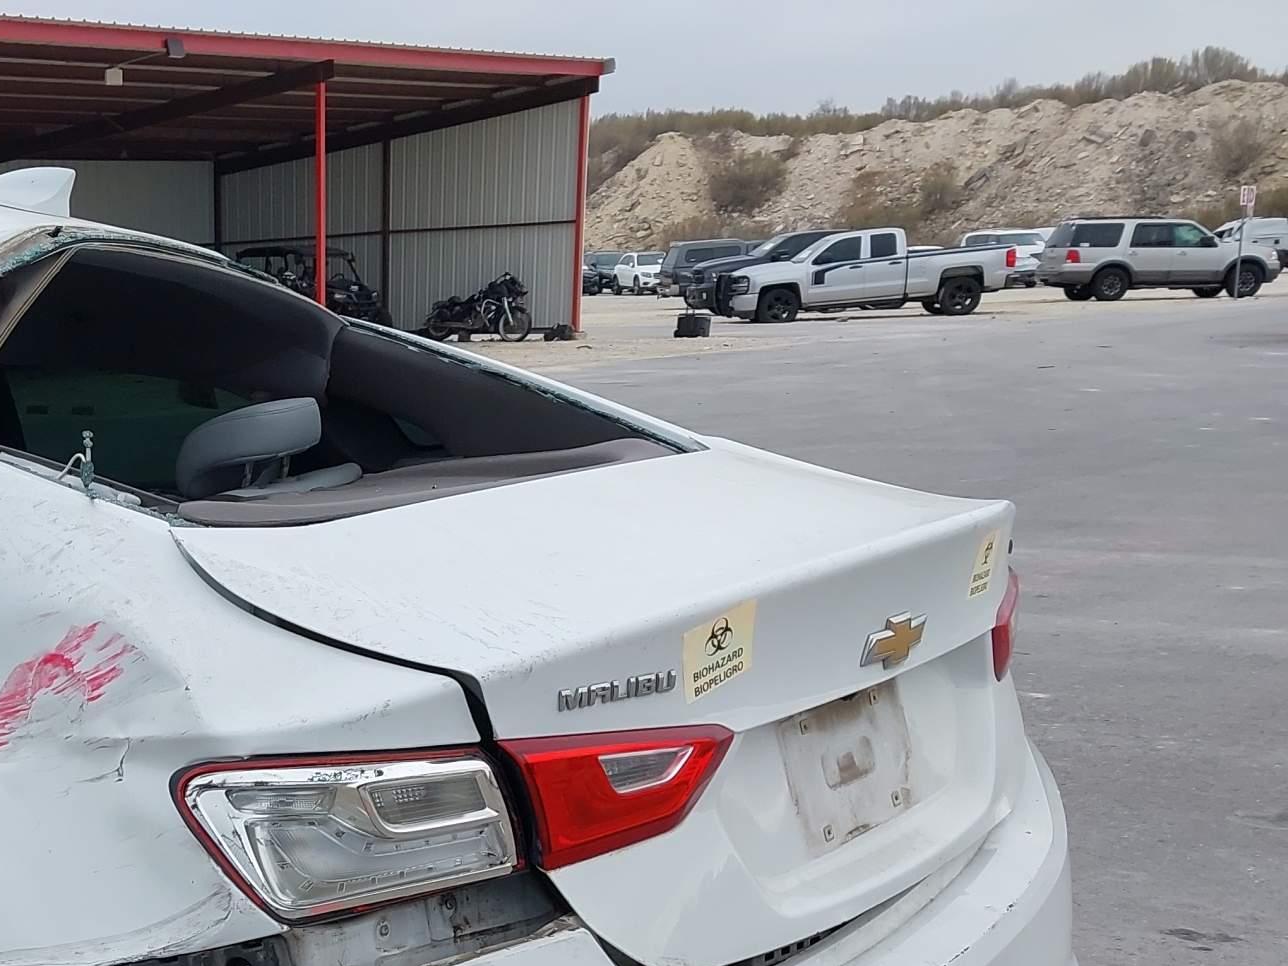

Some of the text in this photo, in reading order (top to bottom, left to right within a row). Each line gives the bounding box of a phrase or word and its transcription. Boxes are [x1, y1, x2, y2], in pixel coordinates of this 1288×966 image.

[693, 647, 744, 683] BIOHAZARD
[694, 661, 744, 697] BIOPELIGRO
[558, 668, 677, 713] MALIBU
